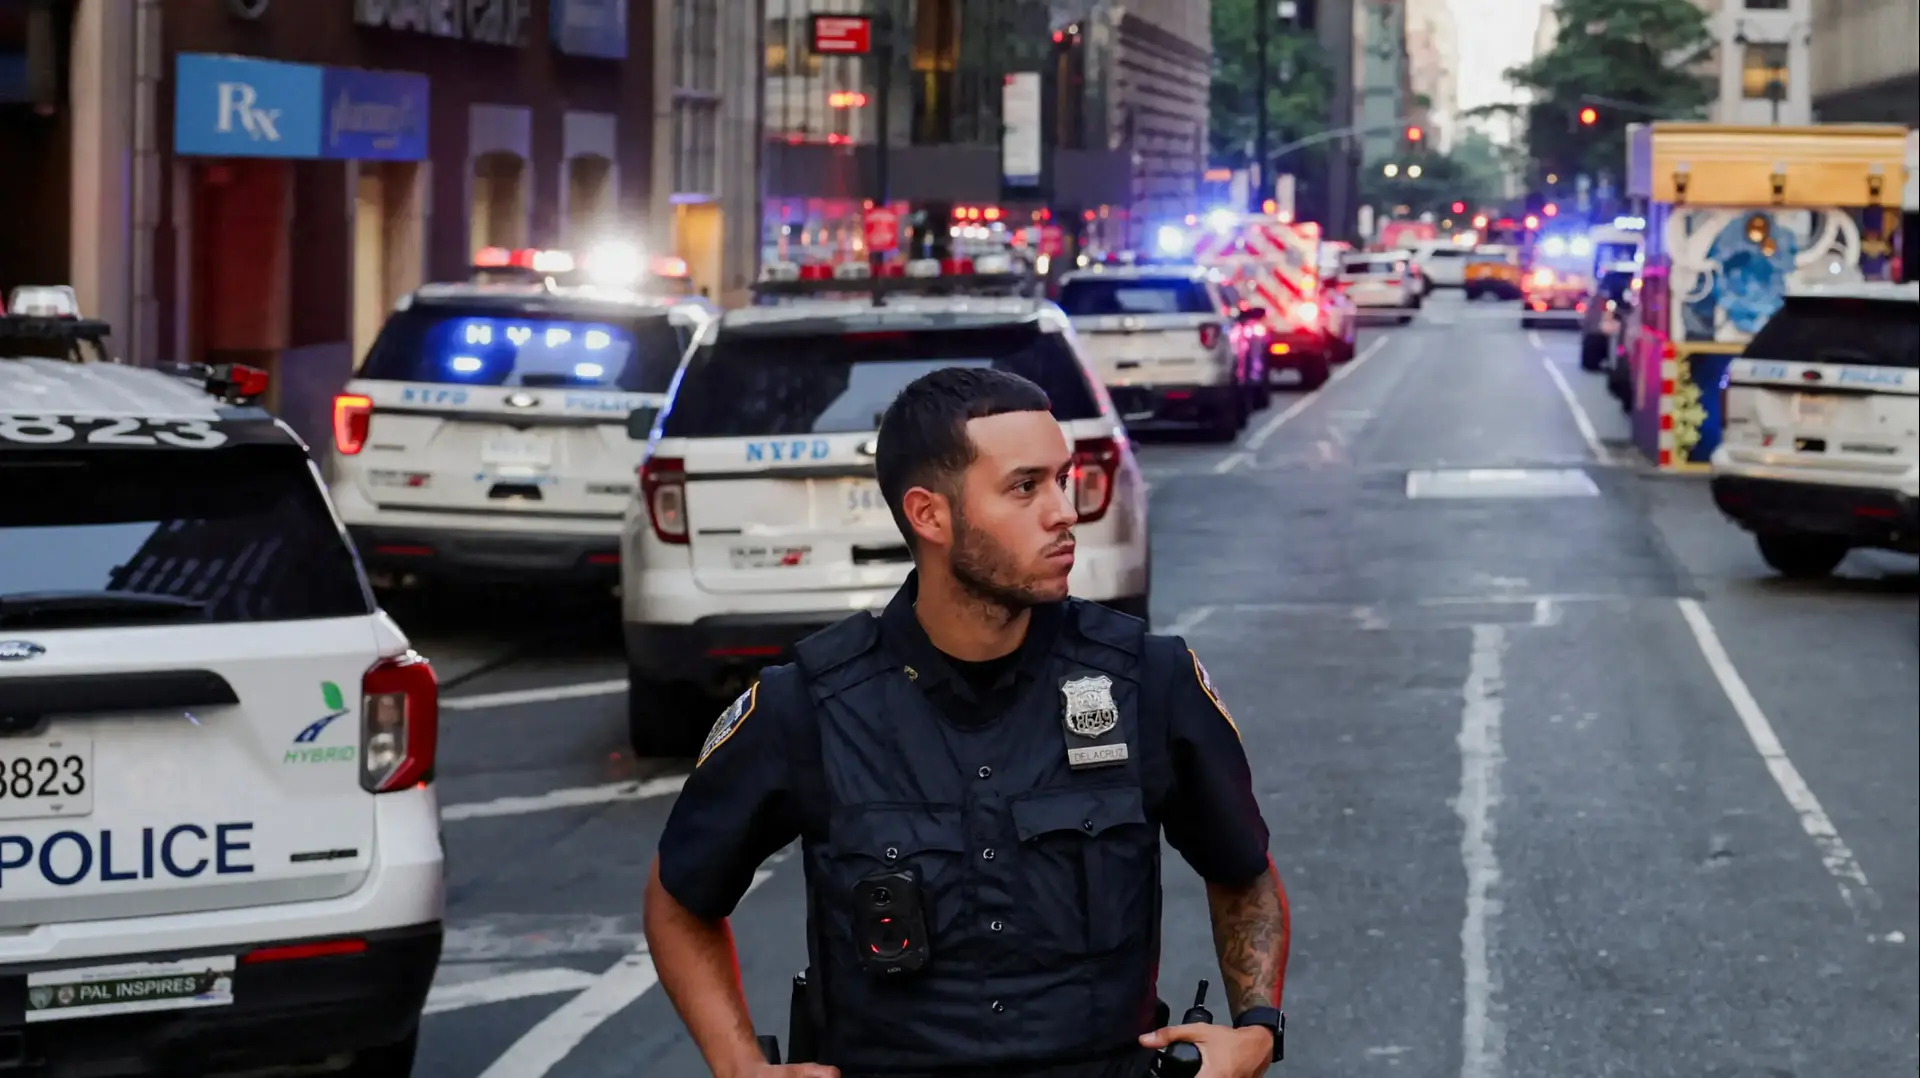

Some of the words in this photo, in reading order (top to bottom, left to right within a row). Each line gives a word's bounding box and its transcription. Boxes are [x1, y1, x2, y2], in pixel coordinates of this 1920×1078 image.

[215, 81, 283, 142] Rx
[465, 323, 611, 350] NYPD
[745, 439, 830, 463] NYPD
[1076, 708, 1113, 731] 8649
[283, 746, 356, 764] HYBRID
[1074, 748, 1123, 762] DELACRUZ
[0, 822, 255, 888] POLICE
[79, 984, 112, 1001] PAL
[116, 976, 196, 998] INSPIRES
